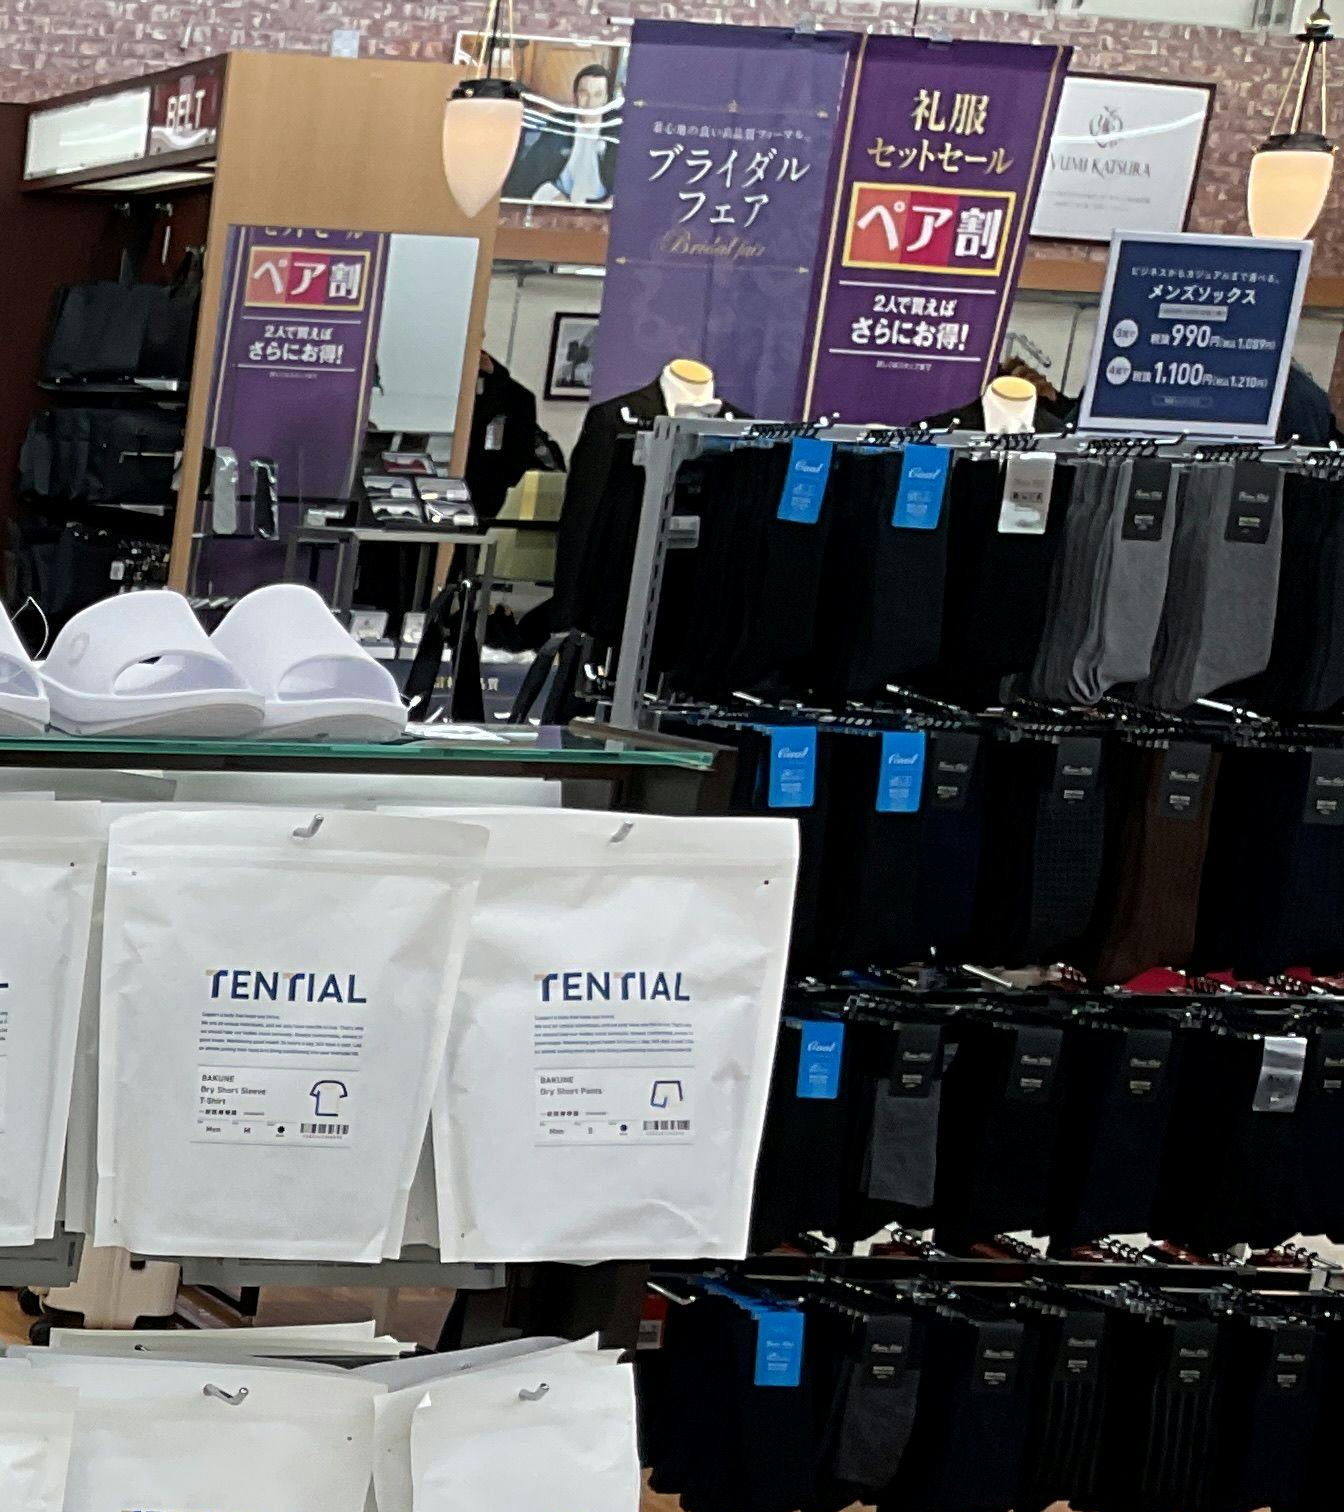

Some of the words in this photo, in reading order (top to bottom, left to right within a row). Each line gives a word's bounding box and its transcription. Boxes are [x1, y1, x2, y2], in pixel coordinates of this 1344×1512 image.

[912, 89, 990, 136] 礼服
[648, 144, 811, 188] ブライダル
[866, 137, 1014, 175] セットセール
[678, 191, 769, 228] フェア
[856, 200, 1003, 260] ペア割
[873, 294, 957, 317] 2人で買えば
[1148, 284, 1256, 304] メンズソックス
[851, 317, 969, 351] さらにお得!
[206, 970, 366, 1003] TENTIAL
[534, 972, 690, 1001] TENTIAL
[201, 1086, 214, 1095] Dry
[202, 1075, 234, 1083] BAKUNE
[200, 1097, 225, 1105] T-Shirt
